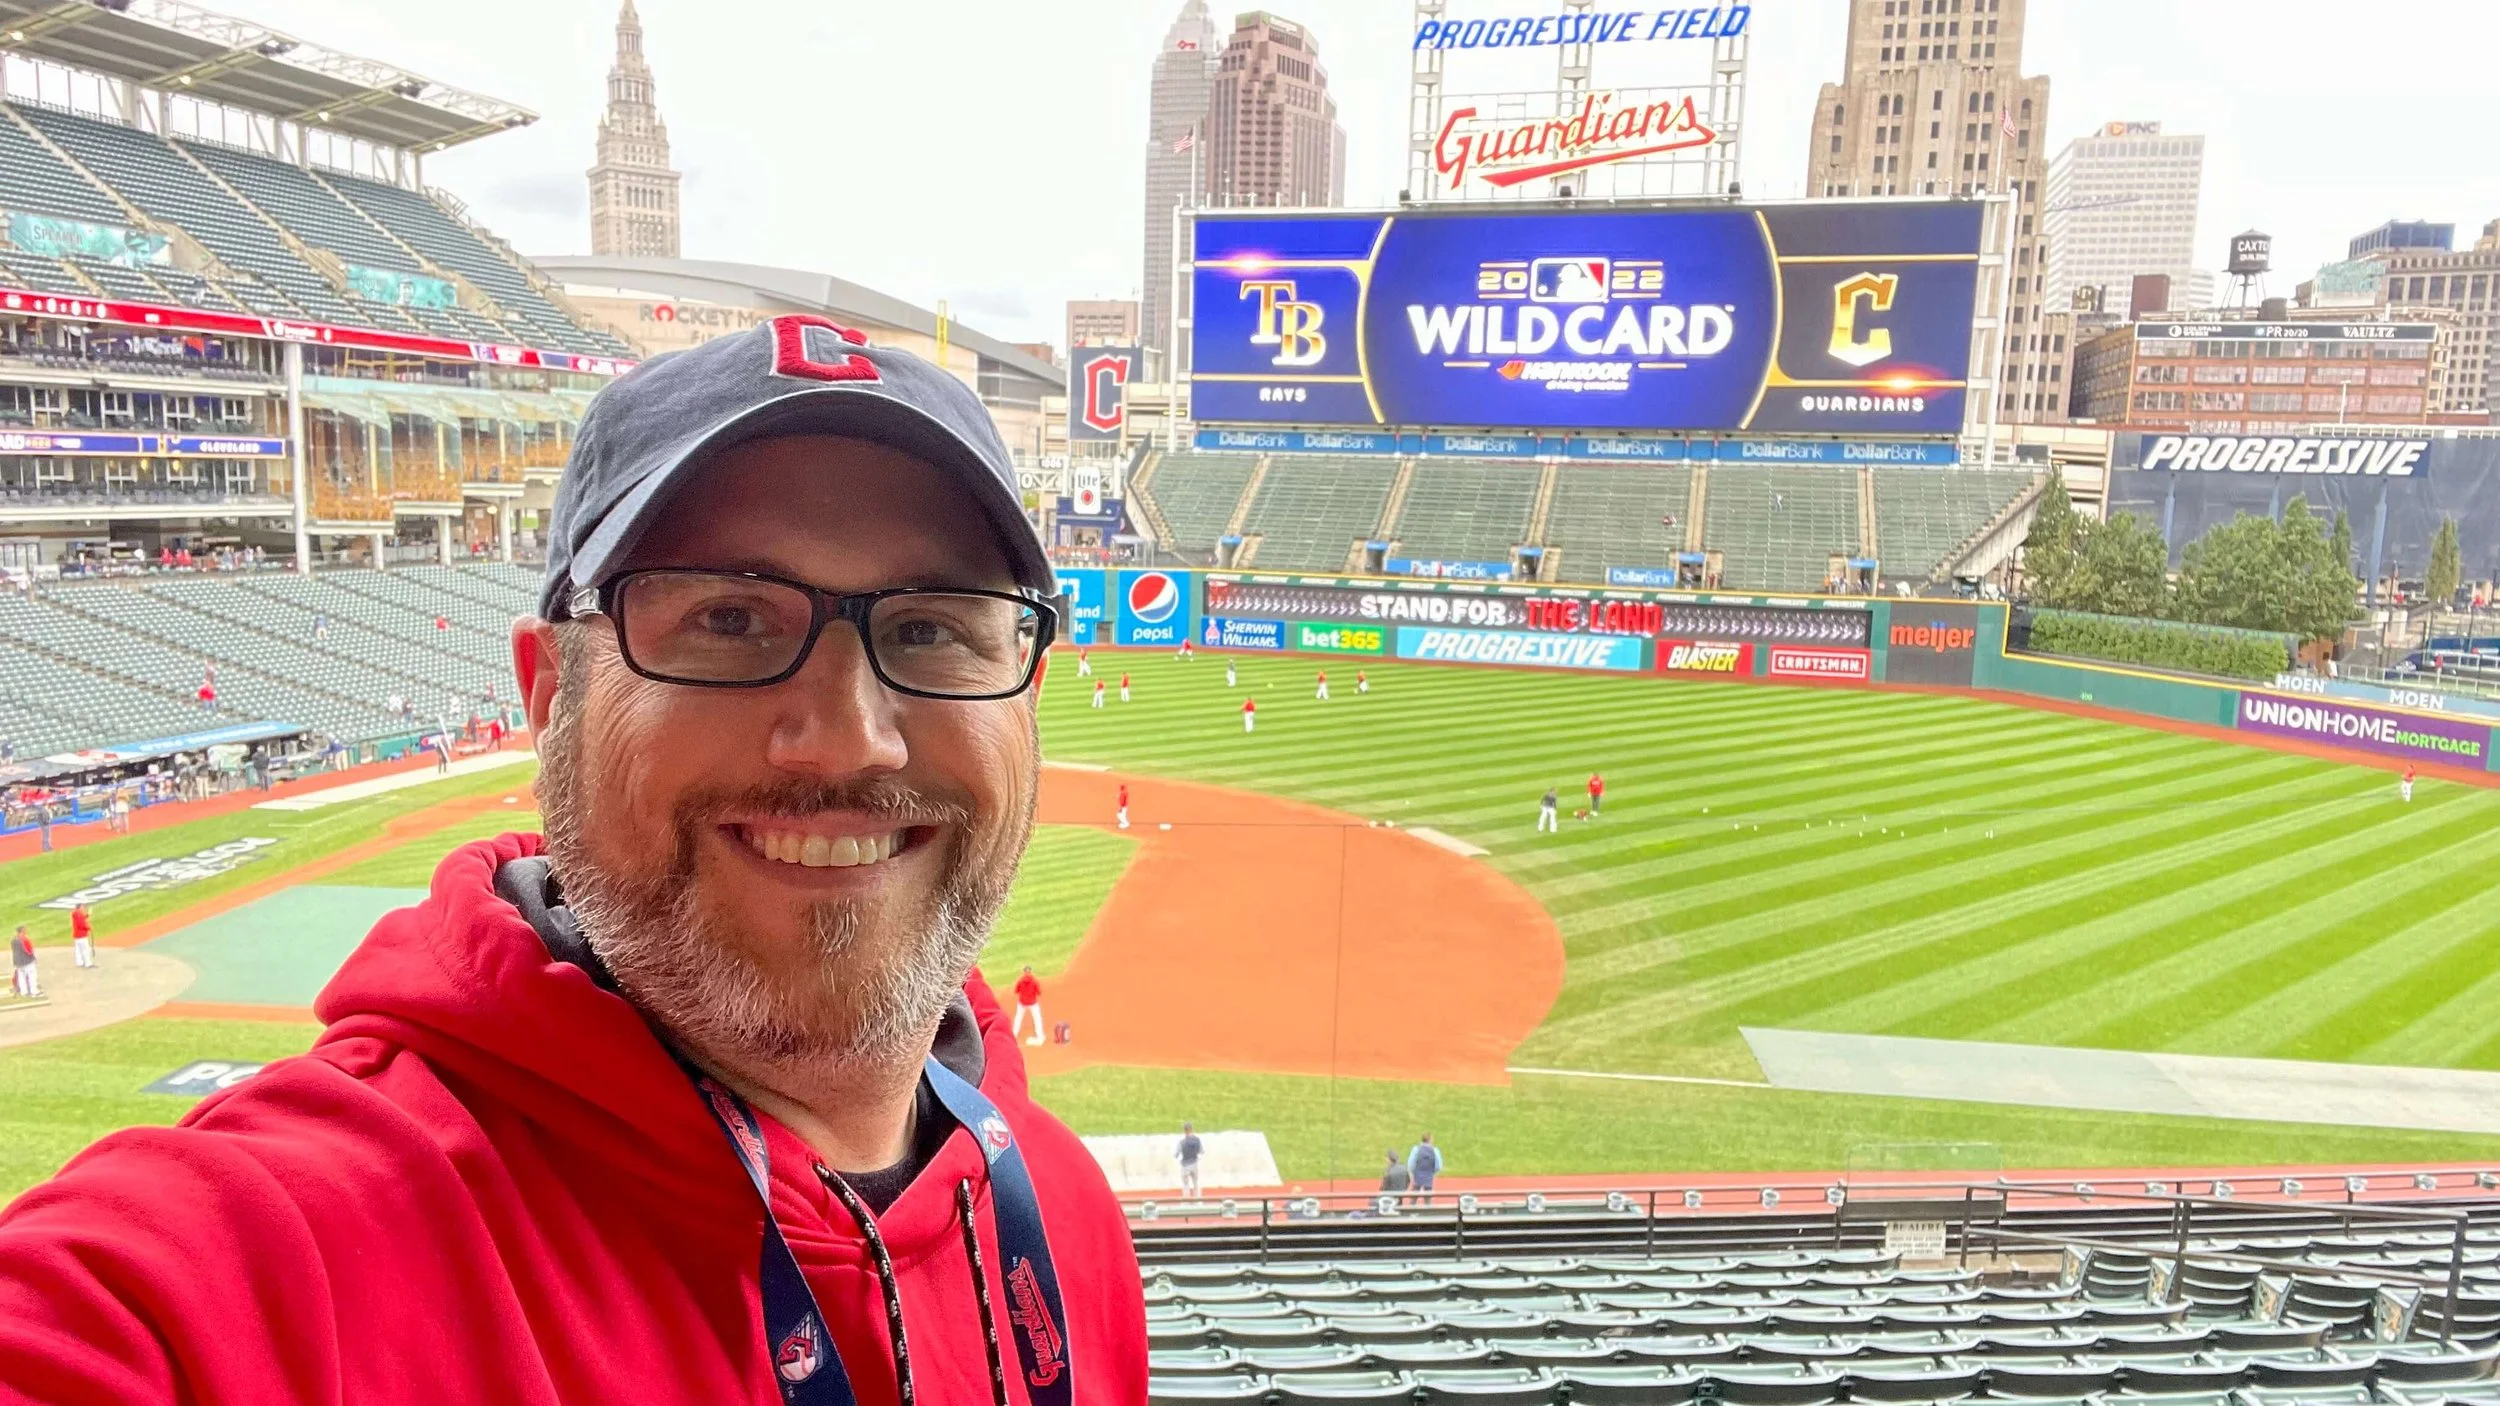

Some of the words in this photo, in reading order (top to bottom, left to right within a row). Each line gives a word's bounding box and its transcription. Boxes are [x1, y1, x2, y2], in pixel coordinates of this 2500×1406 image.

[1412, 11, 1645, 50] PROGRESSIVE
[1650, 5, 1752, 39] FIELD
[2126, 122, 2158, 134] PNC
[1431, 91, 1721, 190] Guardians
[1478, 270, 1528, 290] 20
[1611, 270, 1663, 290] 22
[639, 304, 734, 328] ROCKET
[1828, 271, 1899, 367] C
[1406, 304, 1560, 355] WILD
[1563, 304, 1736, 355] CARD
[2265, 327, 2282, 337] PR
[2342, 326, 2395, 338] VAULTZ
[767, 313, 883, 384] C
[1082, 354, 1131, 433] C
[1259, 387, 1307, 402] RAYS
[1801, 396, 1924, 412] GUARDIANS
[1219, 432, 1288, 448] DollarBank
[1303, 433, 1375, 449] DollarBank
[1444, 436, 1518, 453] DollarBank
[1587, 439, 1665, 456] DollarBank
[1741, 442, 1824, 460] DollarBank
[1843, 442, 1928, 461] DollarBank
[2143, 436, 2428, 476] PROGRESSIVE
[1077, 474, 1098, 489] Lite
[1360, 595, 1449, 621] STAND
[1450, 599, 1508, 626] FOR
[1525, 597, 1582, 632] THE
[1588, 600, 1664, 638] LAND
[1132, 625, 1174, 642] pepsi
[1223, 620, 1278, 636] SHERWIN
[1890, 620, 1975, 653] meijer
[1222, 632, 1279, 649] WILLIAMS
[1302, 627, 1381, 651] bet365
[1415, 630, 1619, 667] PROGRESSIVE
[1667, 646, 1740, 673] BLASTER
[1777, 655, 1861, 672] CRAFTSMAN
[2275, 672, 2326, 694] MOEN
[2389, 688, 2445, 710] MOEN
[1007, 1256, 1065, 1386] Guardians
